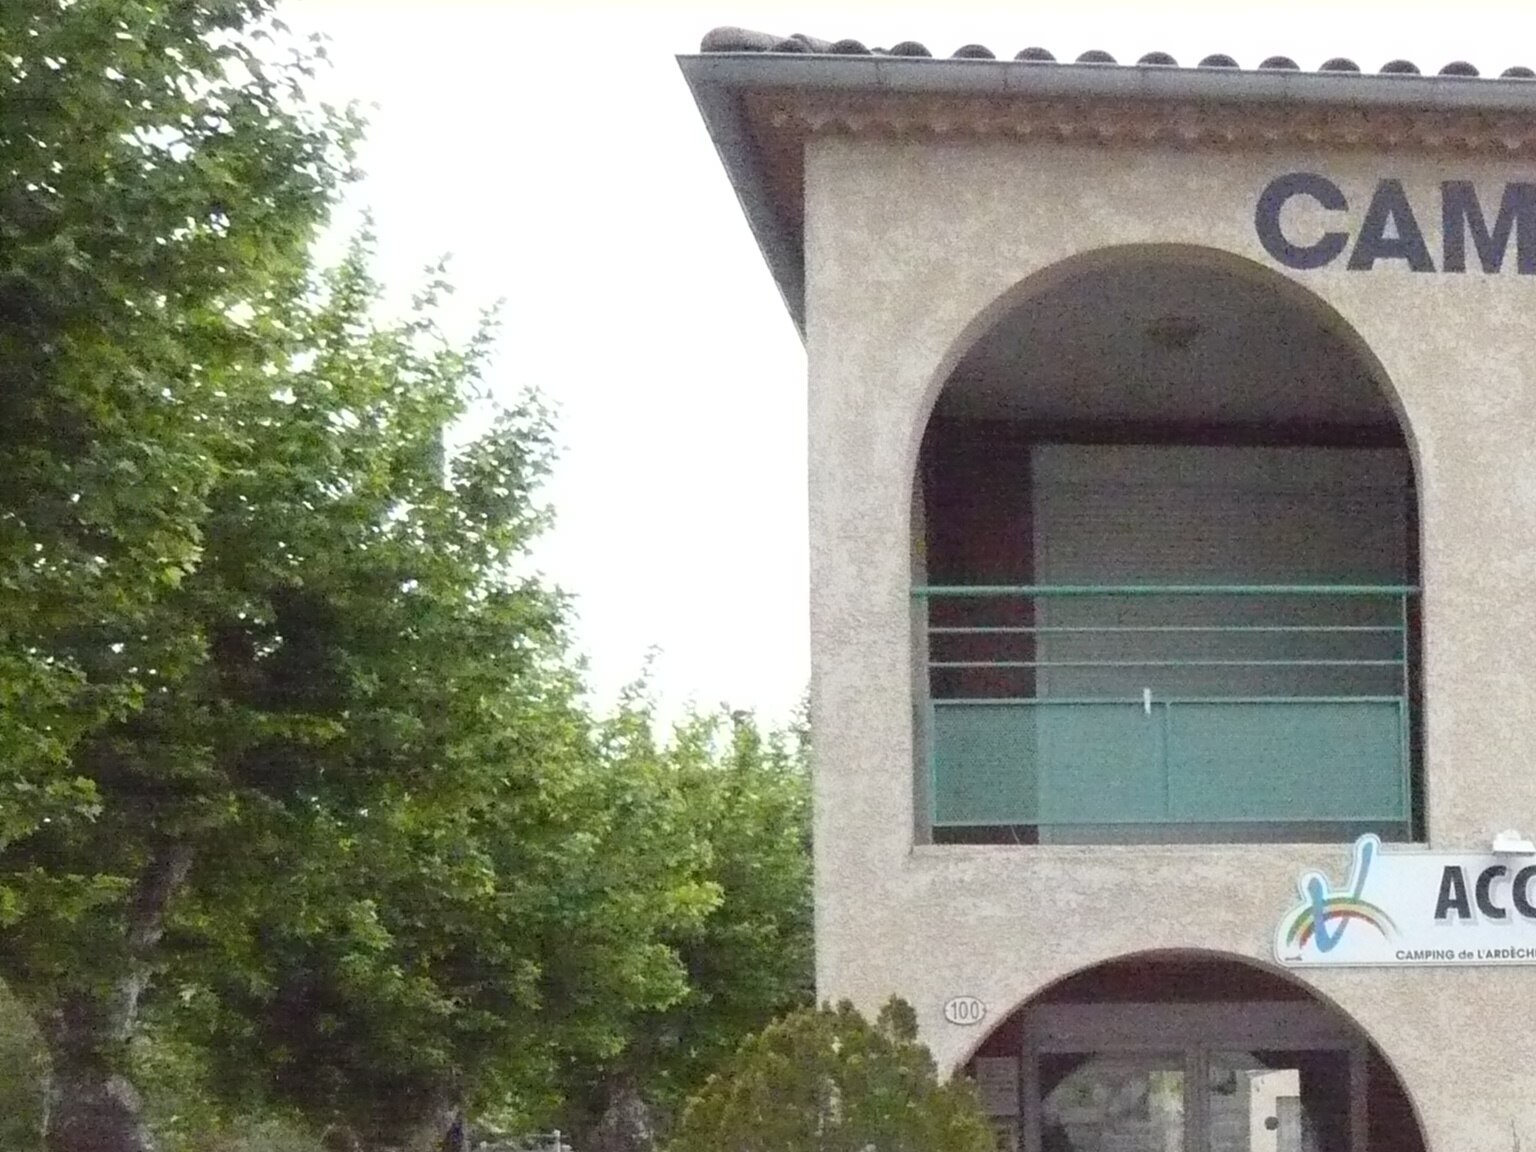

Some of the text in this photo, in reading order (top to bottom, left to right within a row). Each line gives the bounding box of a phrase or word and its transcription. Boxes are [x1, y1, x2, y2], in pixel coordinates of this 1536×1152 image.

[1395, 949, 1455, 961] CAMPING
[1458, 950, 1474, 961] de
[950, 1000, 980, 1021] 100
